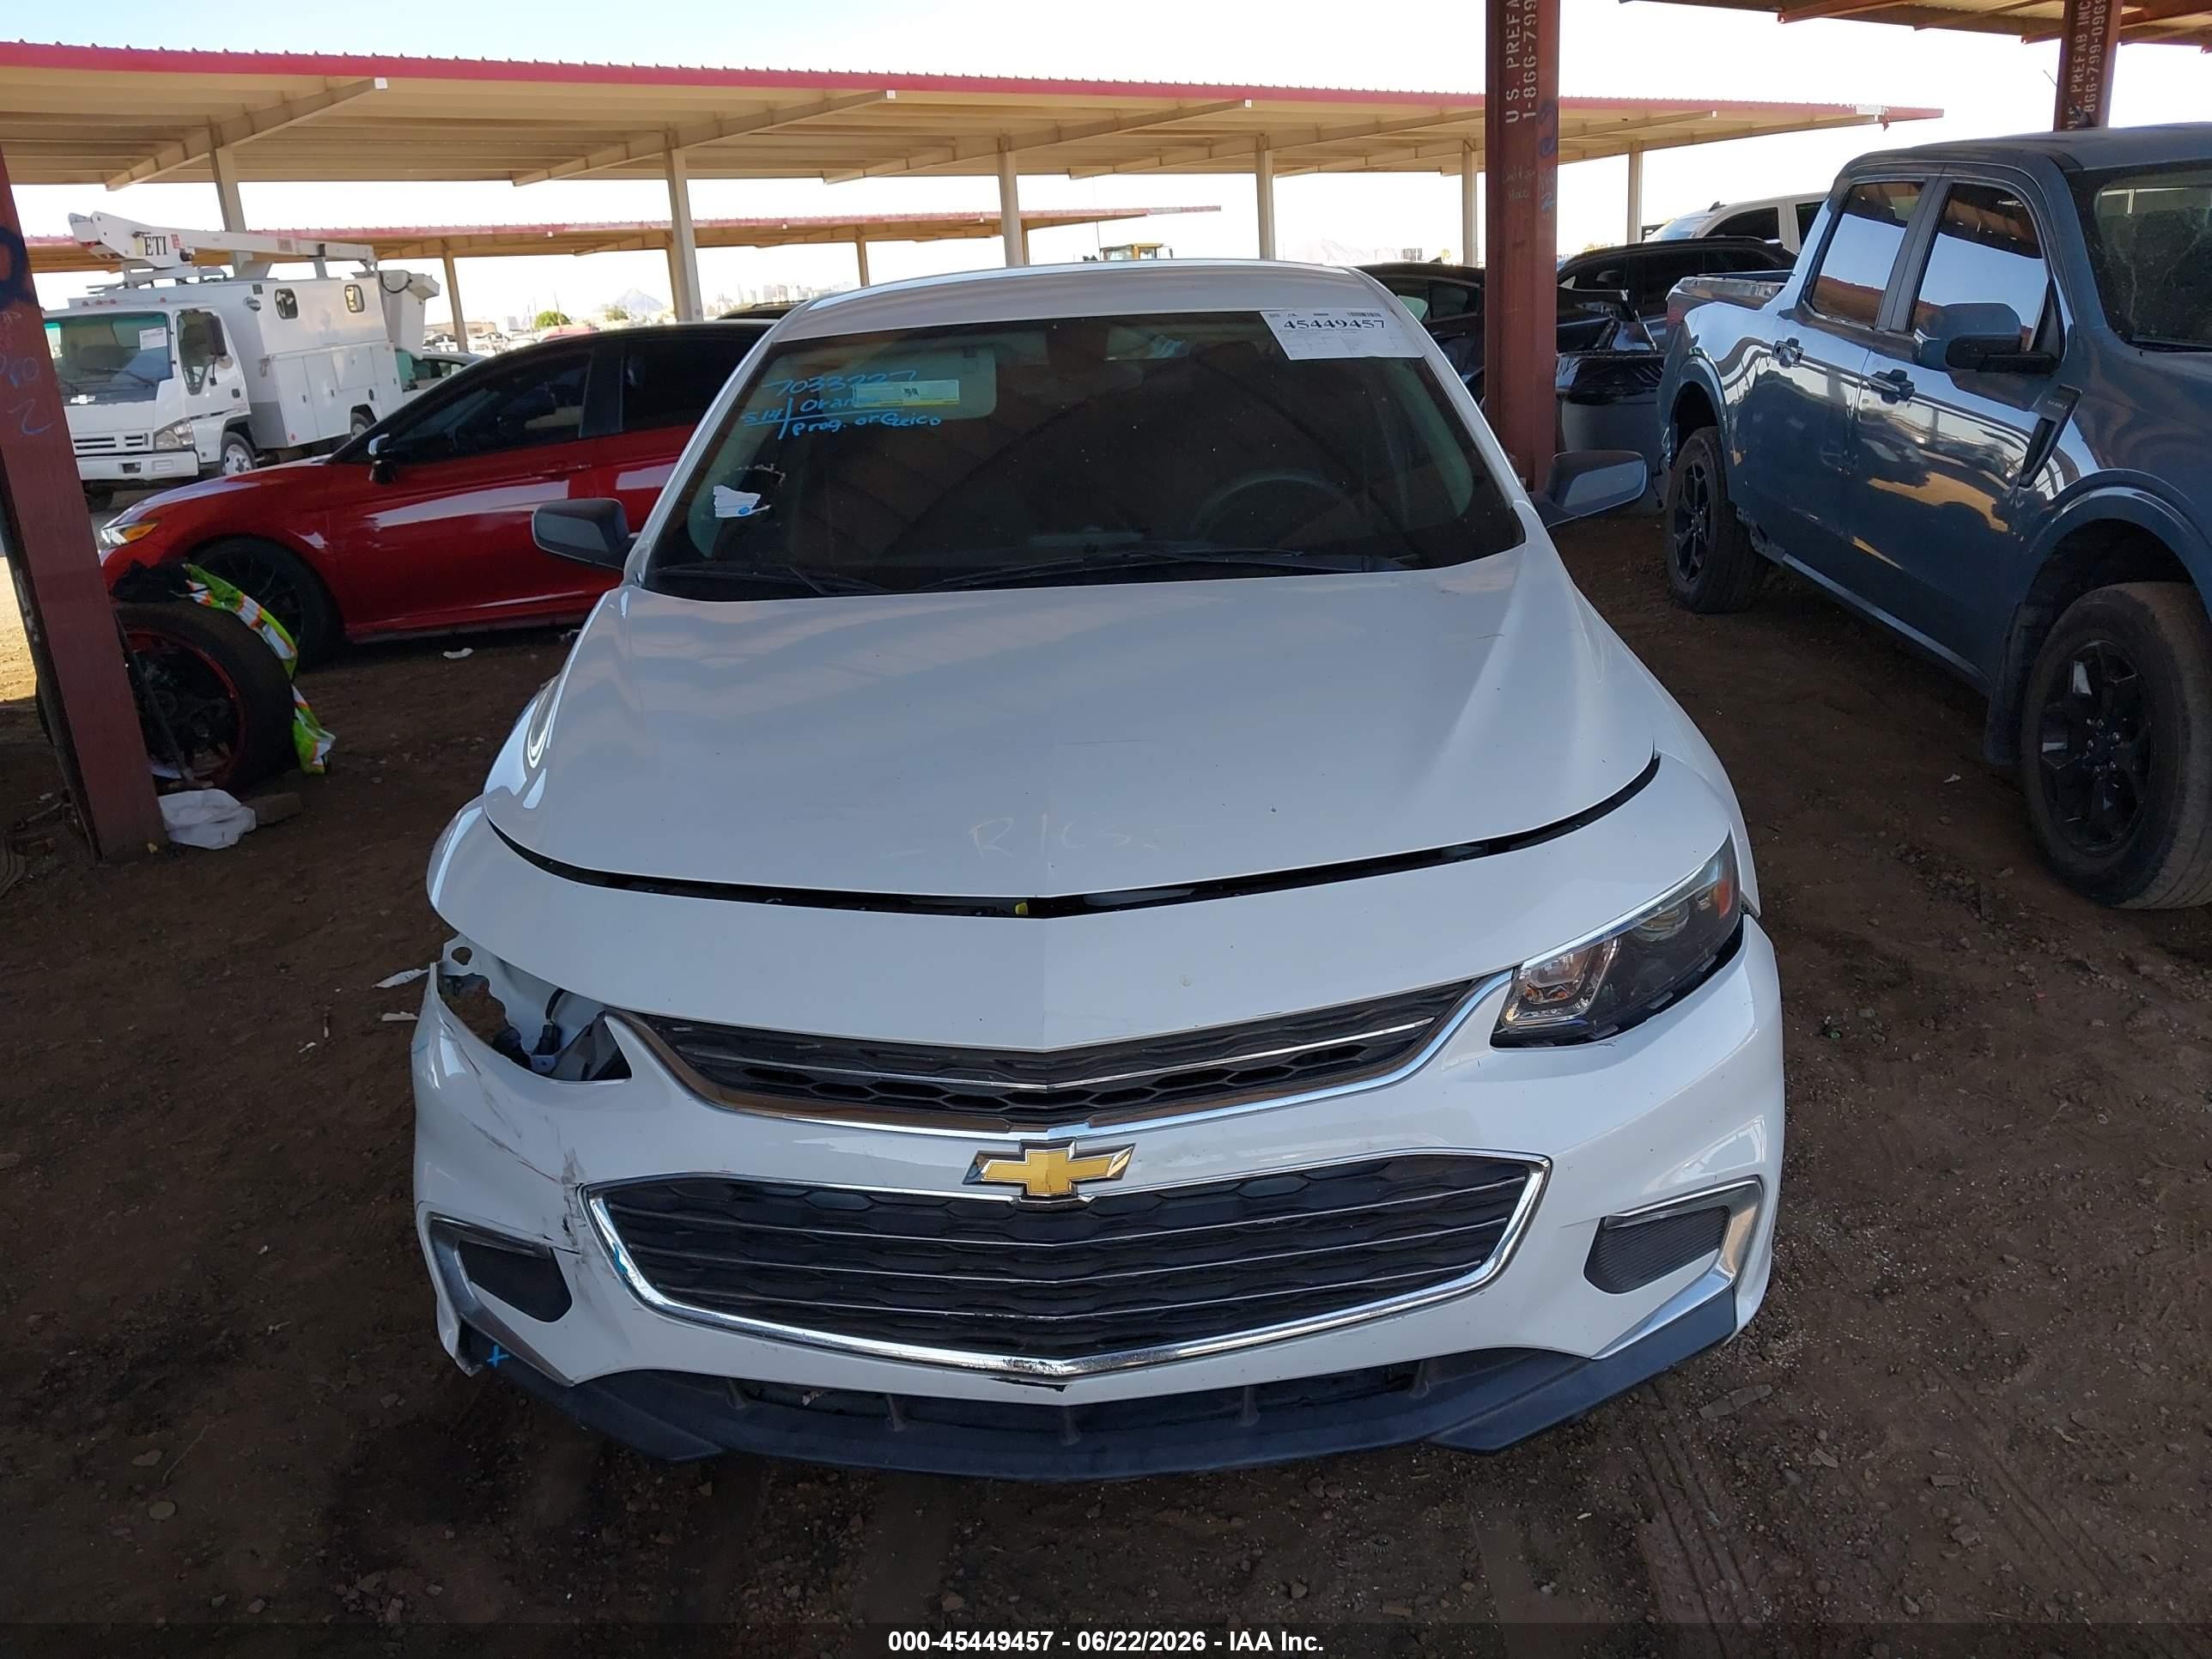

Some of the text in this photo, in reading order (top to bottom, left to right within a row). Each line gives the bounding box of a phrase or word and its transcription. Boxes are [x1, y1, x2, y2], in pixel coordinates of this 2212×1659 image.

[2070, 33, 2087, 93] PREFAB
[144, 235, 167, 256] ETI
[1284, 319, 1385, 329] 45449457
